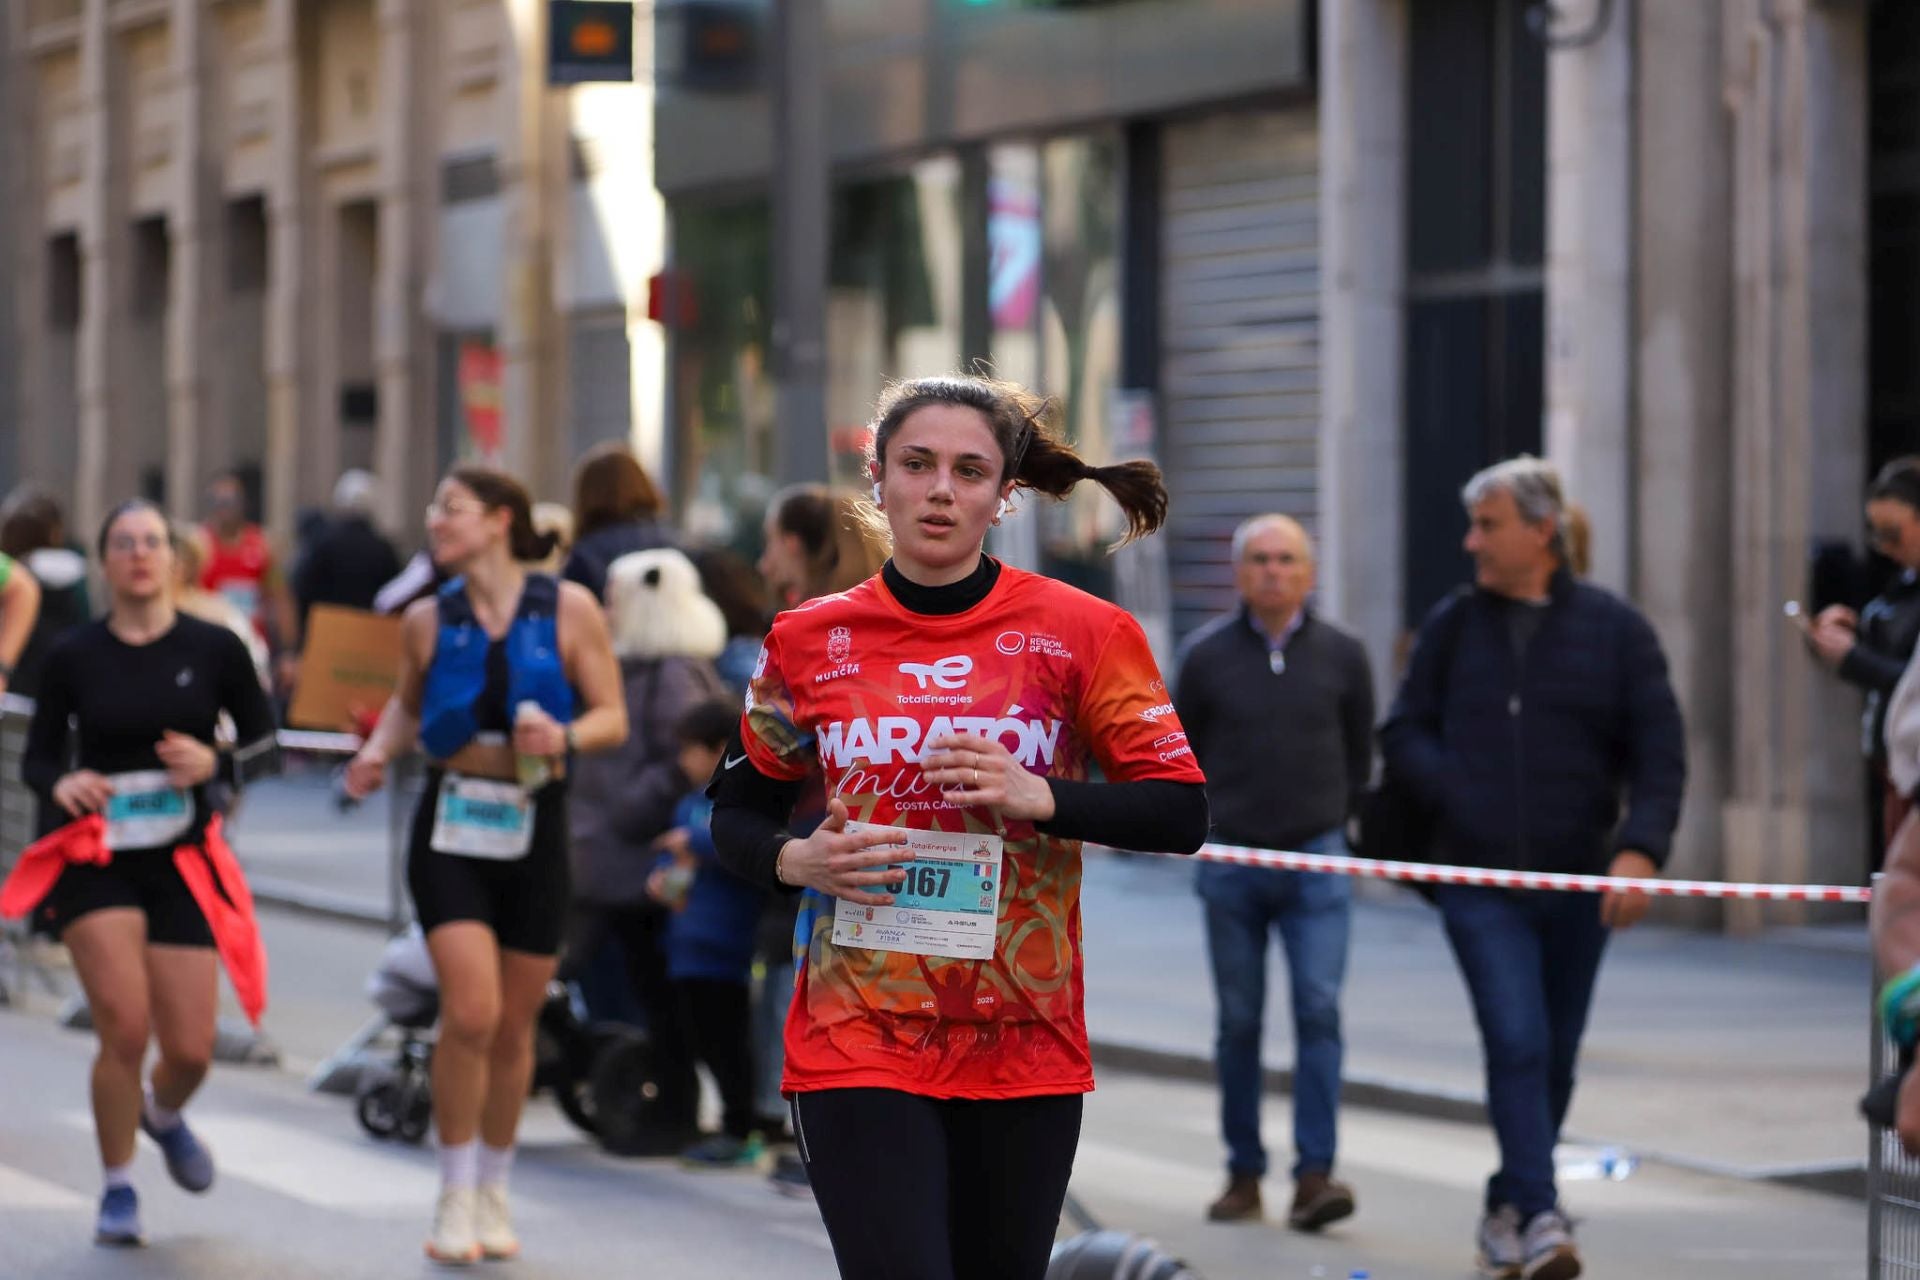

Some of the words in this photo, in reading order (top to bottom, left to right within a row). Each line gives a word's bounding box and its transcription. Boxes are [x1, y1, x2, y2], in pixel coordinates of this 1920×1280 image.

[897, 695, 973, 705] TotalEnergies
[815, 704, 1063, 768] MARATÓN
[895, 801, 931, 811] COSTA
[911, 842, 957, 852] TotalEnergies
[976, 996, 994, 1005] 2025
